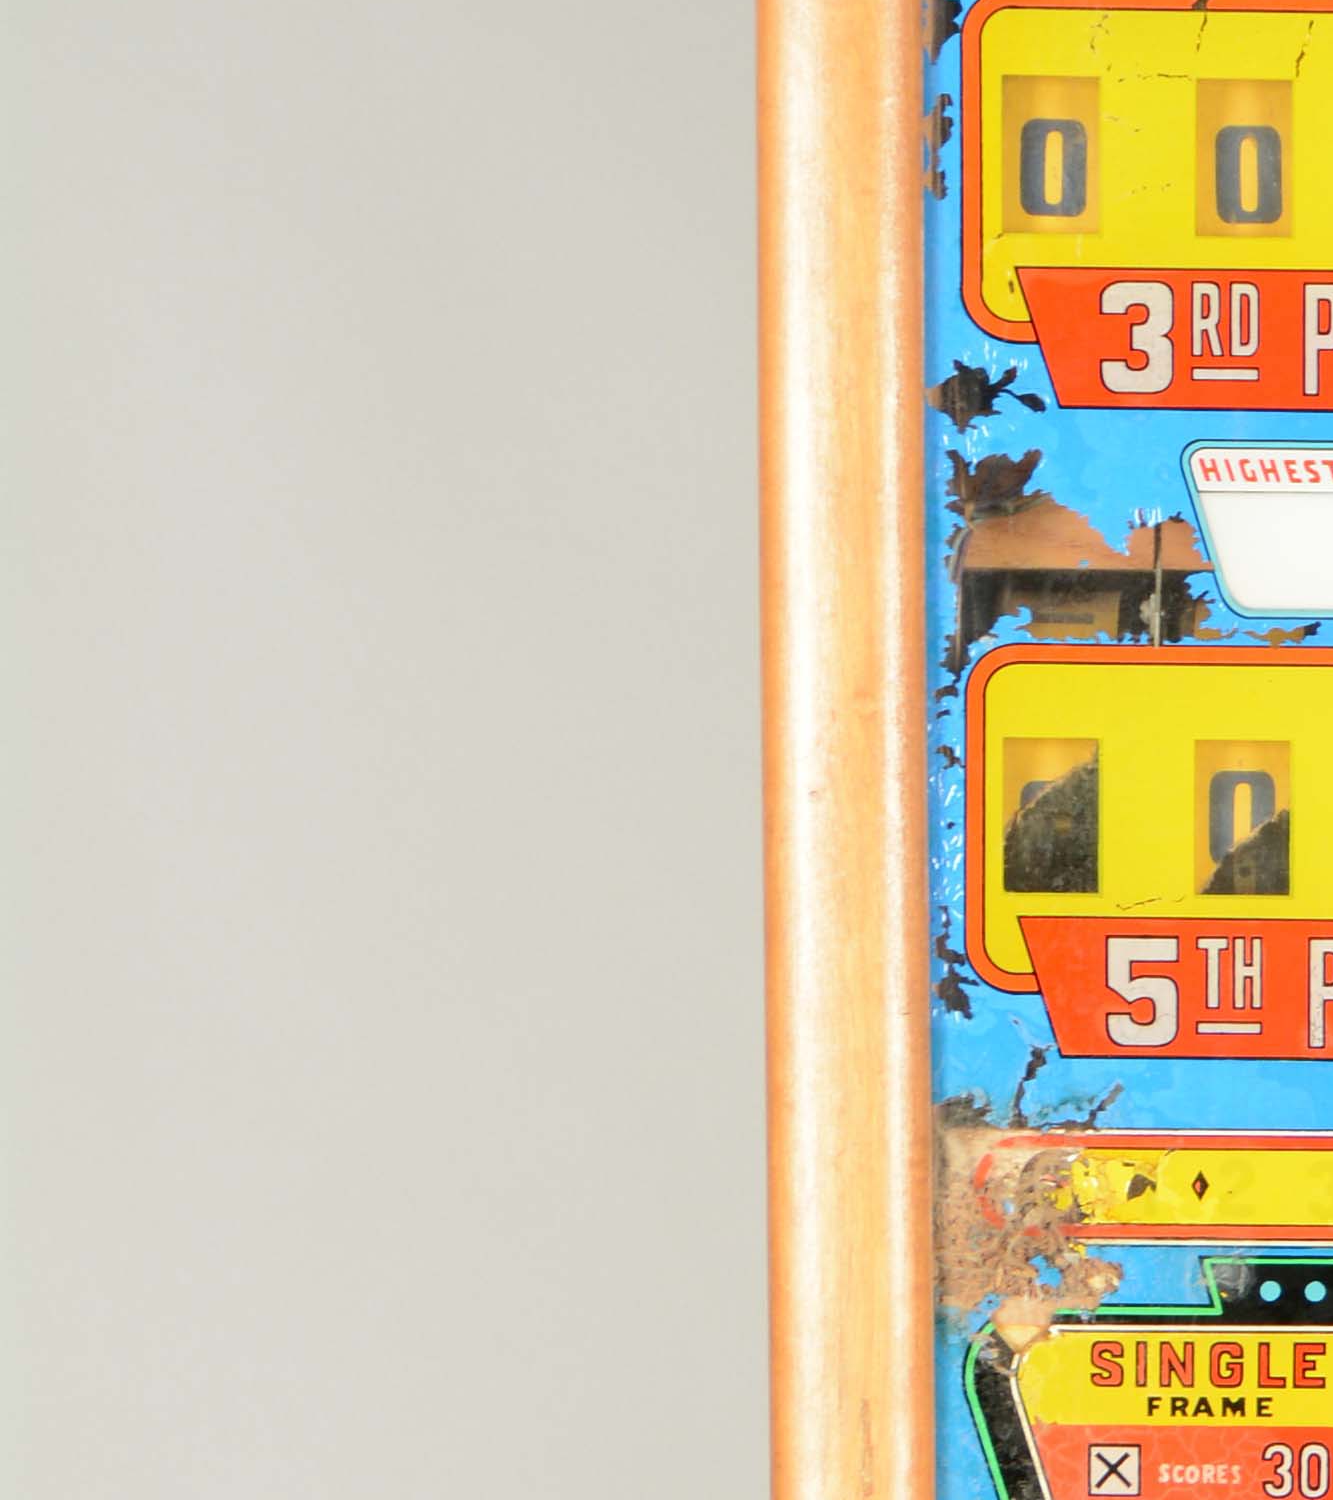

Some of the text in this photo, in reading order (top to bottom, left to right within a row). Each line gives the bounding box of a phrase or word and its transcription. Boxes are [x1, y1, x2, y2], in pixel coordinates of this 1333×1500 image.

[1019, 117, 1088, 218] 0
[1214, 123, 1283, 224] 0
[1099, 279, 1260, 395] 3RD
[1105, 935, 1263, 1048] 5TH
[1090, 1340, 1326, 1389] SINGLE
[1147, 1397, 1273, 1417] FRAME
[1157, 1442, 1330, 1500] SCORES 30
